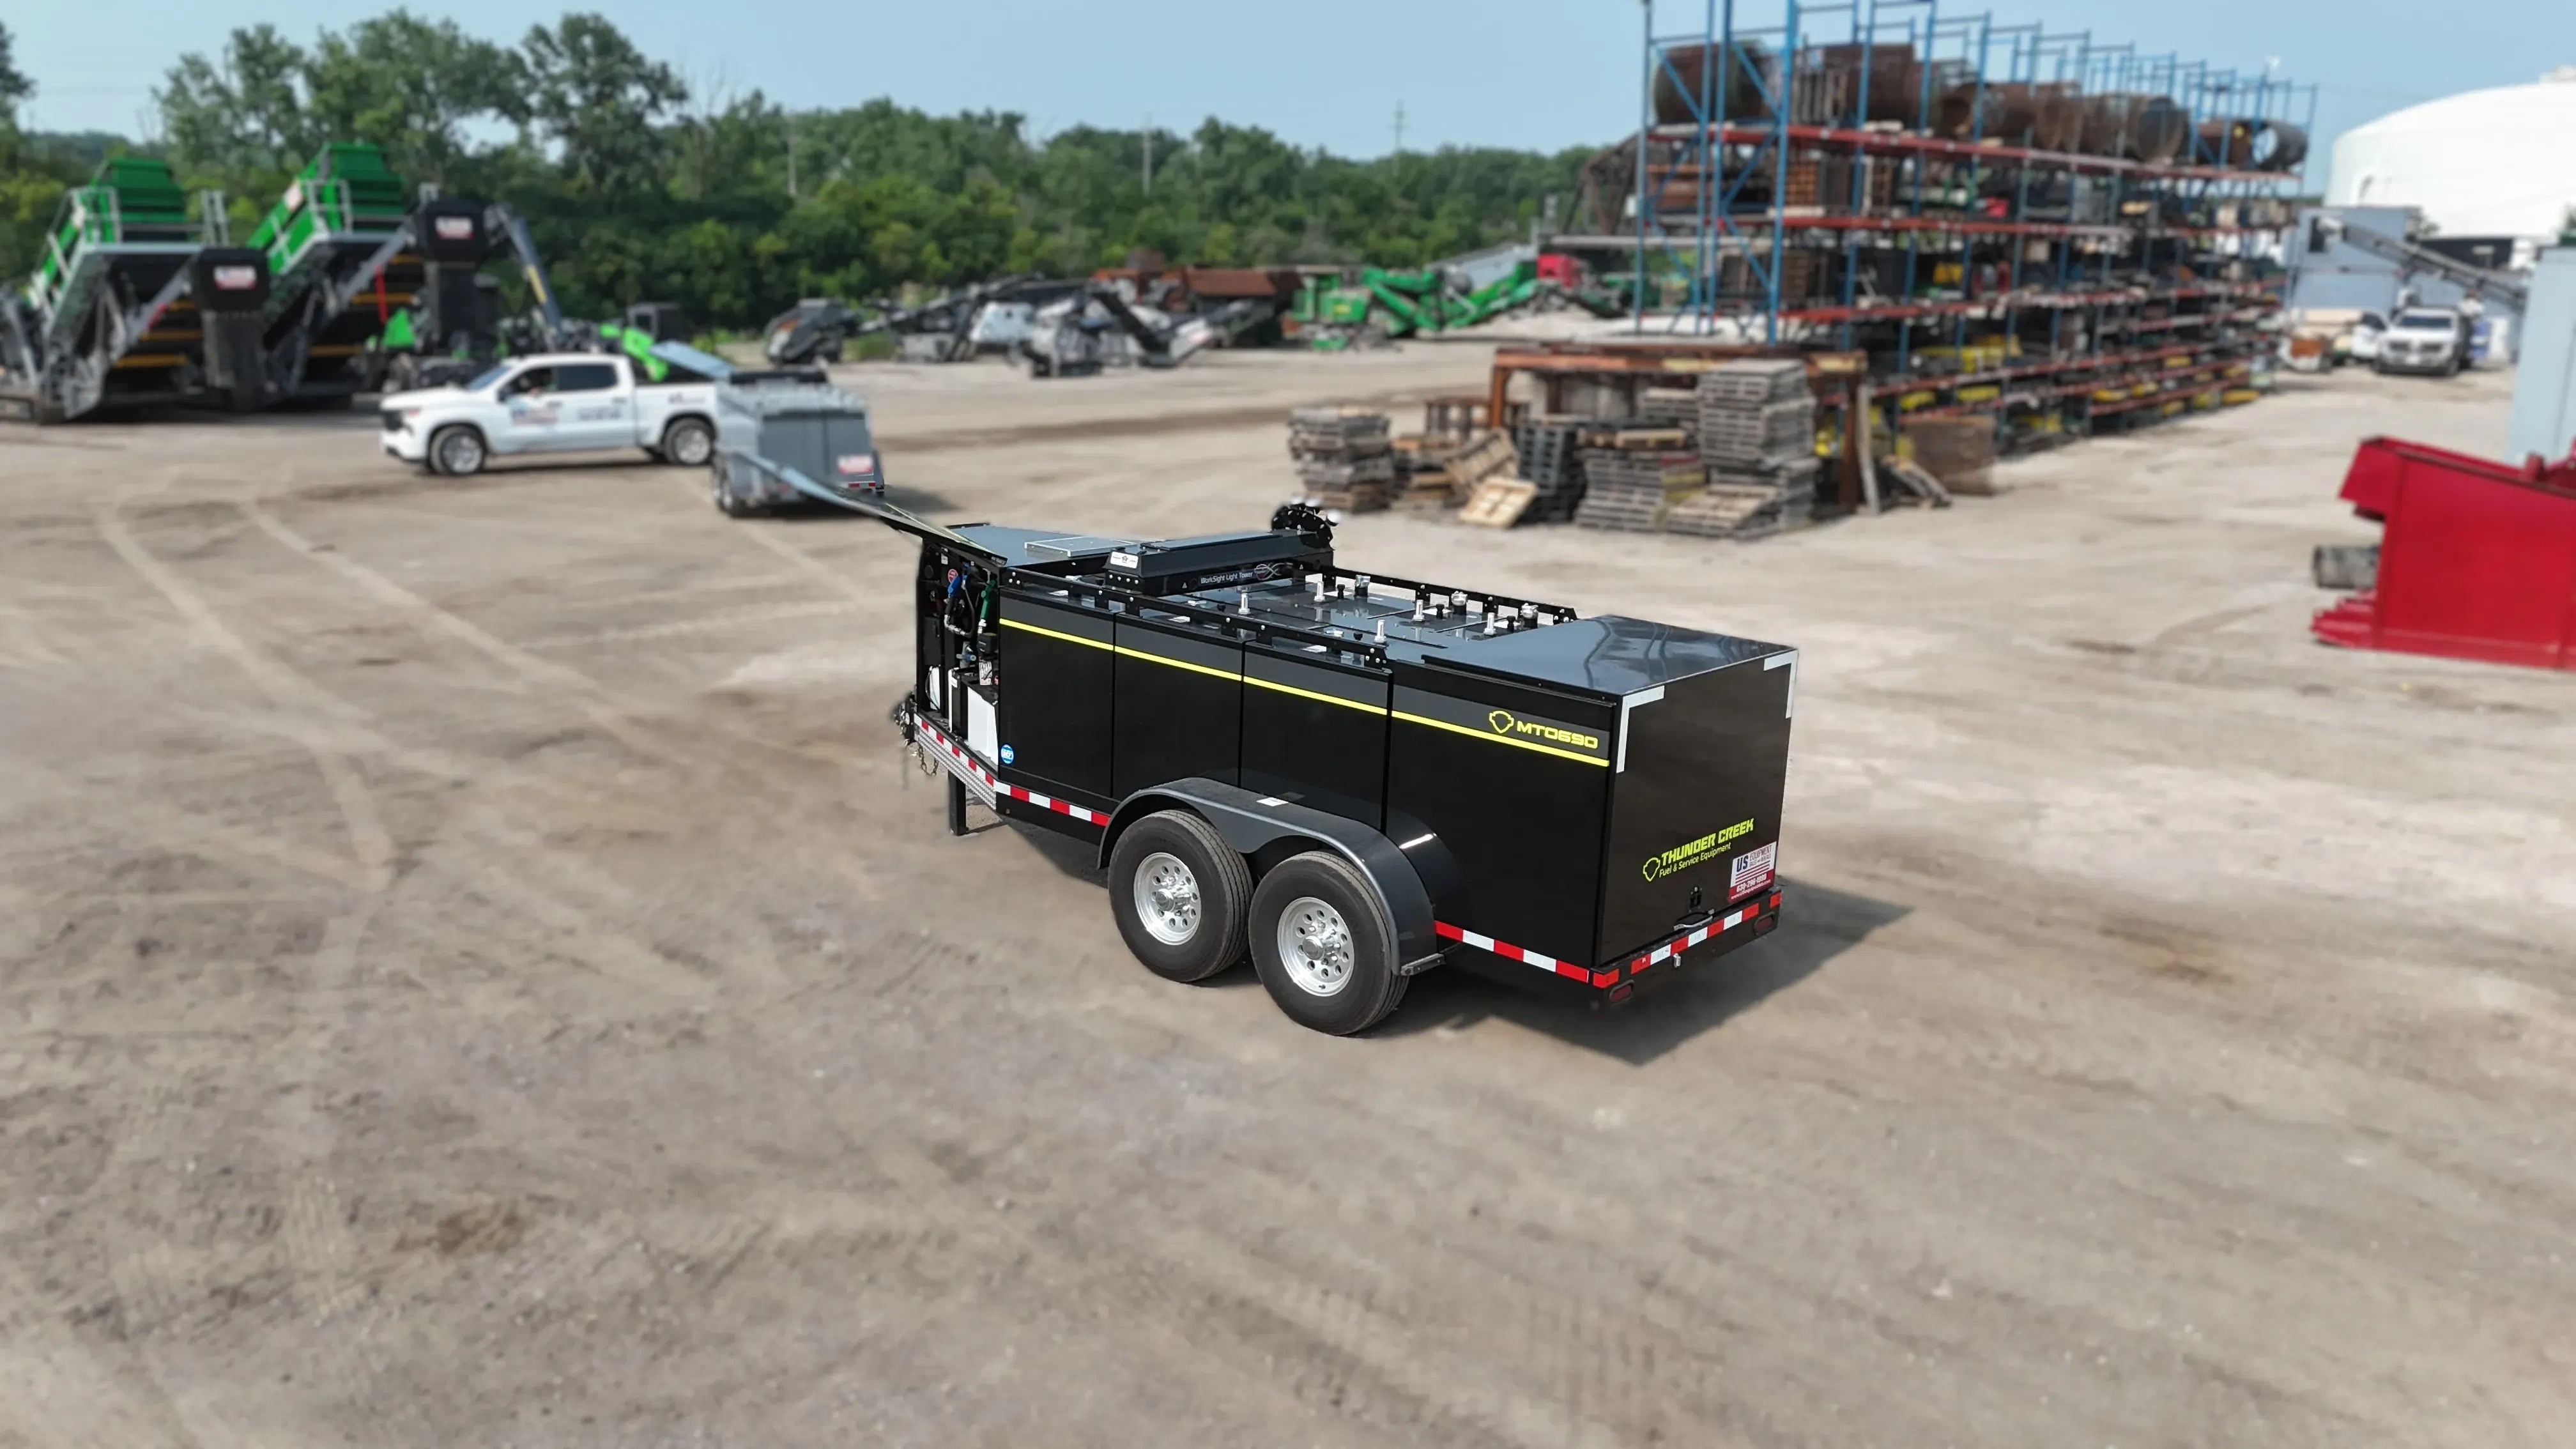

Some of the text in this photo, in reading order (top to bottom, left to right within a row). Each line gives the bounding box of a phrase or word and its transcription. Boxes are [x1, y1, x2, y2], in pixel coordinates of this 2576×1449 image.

[1226, 573, 1238, 582] Light
[1661, 818, 1755, 866] THUNDER CREEK
[1659, 841, 1731, 878] Fuel & Service Equipment
[1736, 855, 1749, 873] US
